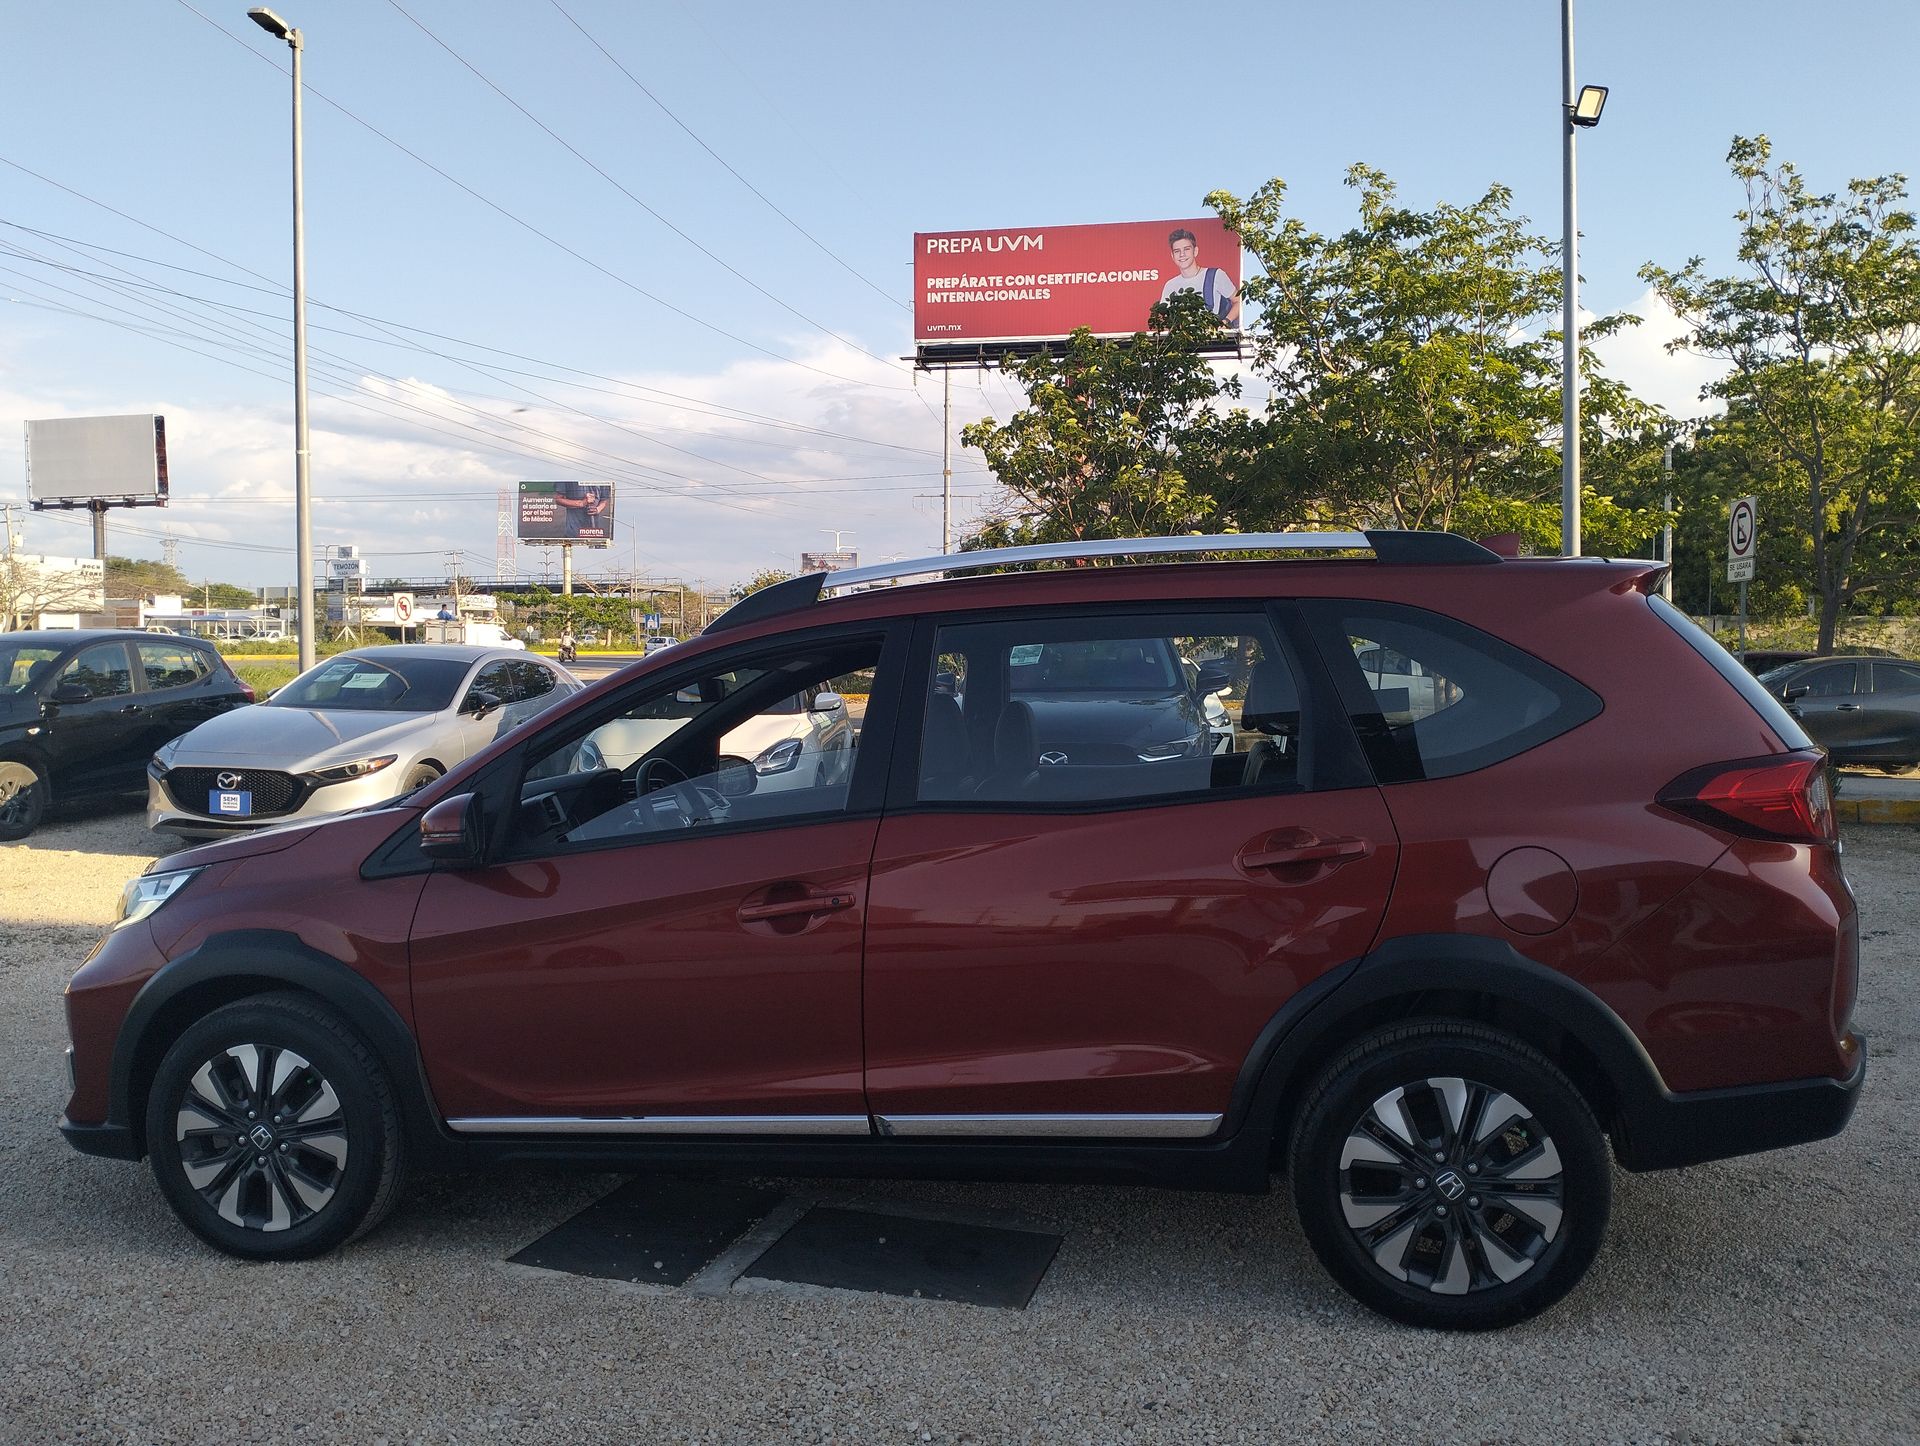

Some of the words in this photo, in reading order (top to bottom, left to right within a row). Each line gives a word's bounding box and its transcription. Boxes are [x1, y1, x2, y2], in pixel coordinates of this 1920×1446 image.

[927, 238, 982, 254] PREPA
[986, 235, 1044, 252] UVM
[927, 274, 1003, 289] PREPÁRATE
[1005, 274, 1035, 286] CON
[1037, 269, 1159, 285] CERTIFICACIONES
[927, 288, 1051, 303] INTERNACIONALES
[927, 323, 962, 332] uvm.mx
